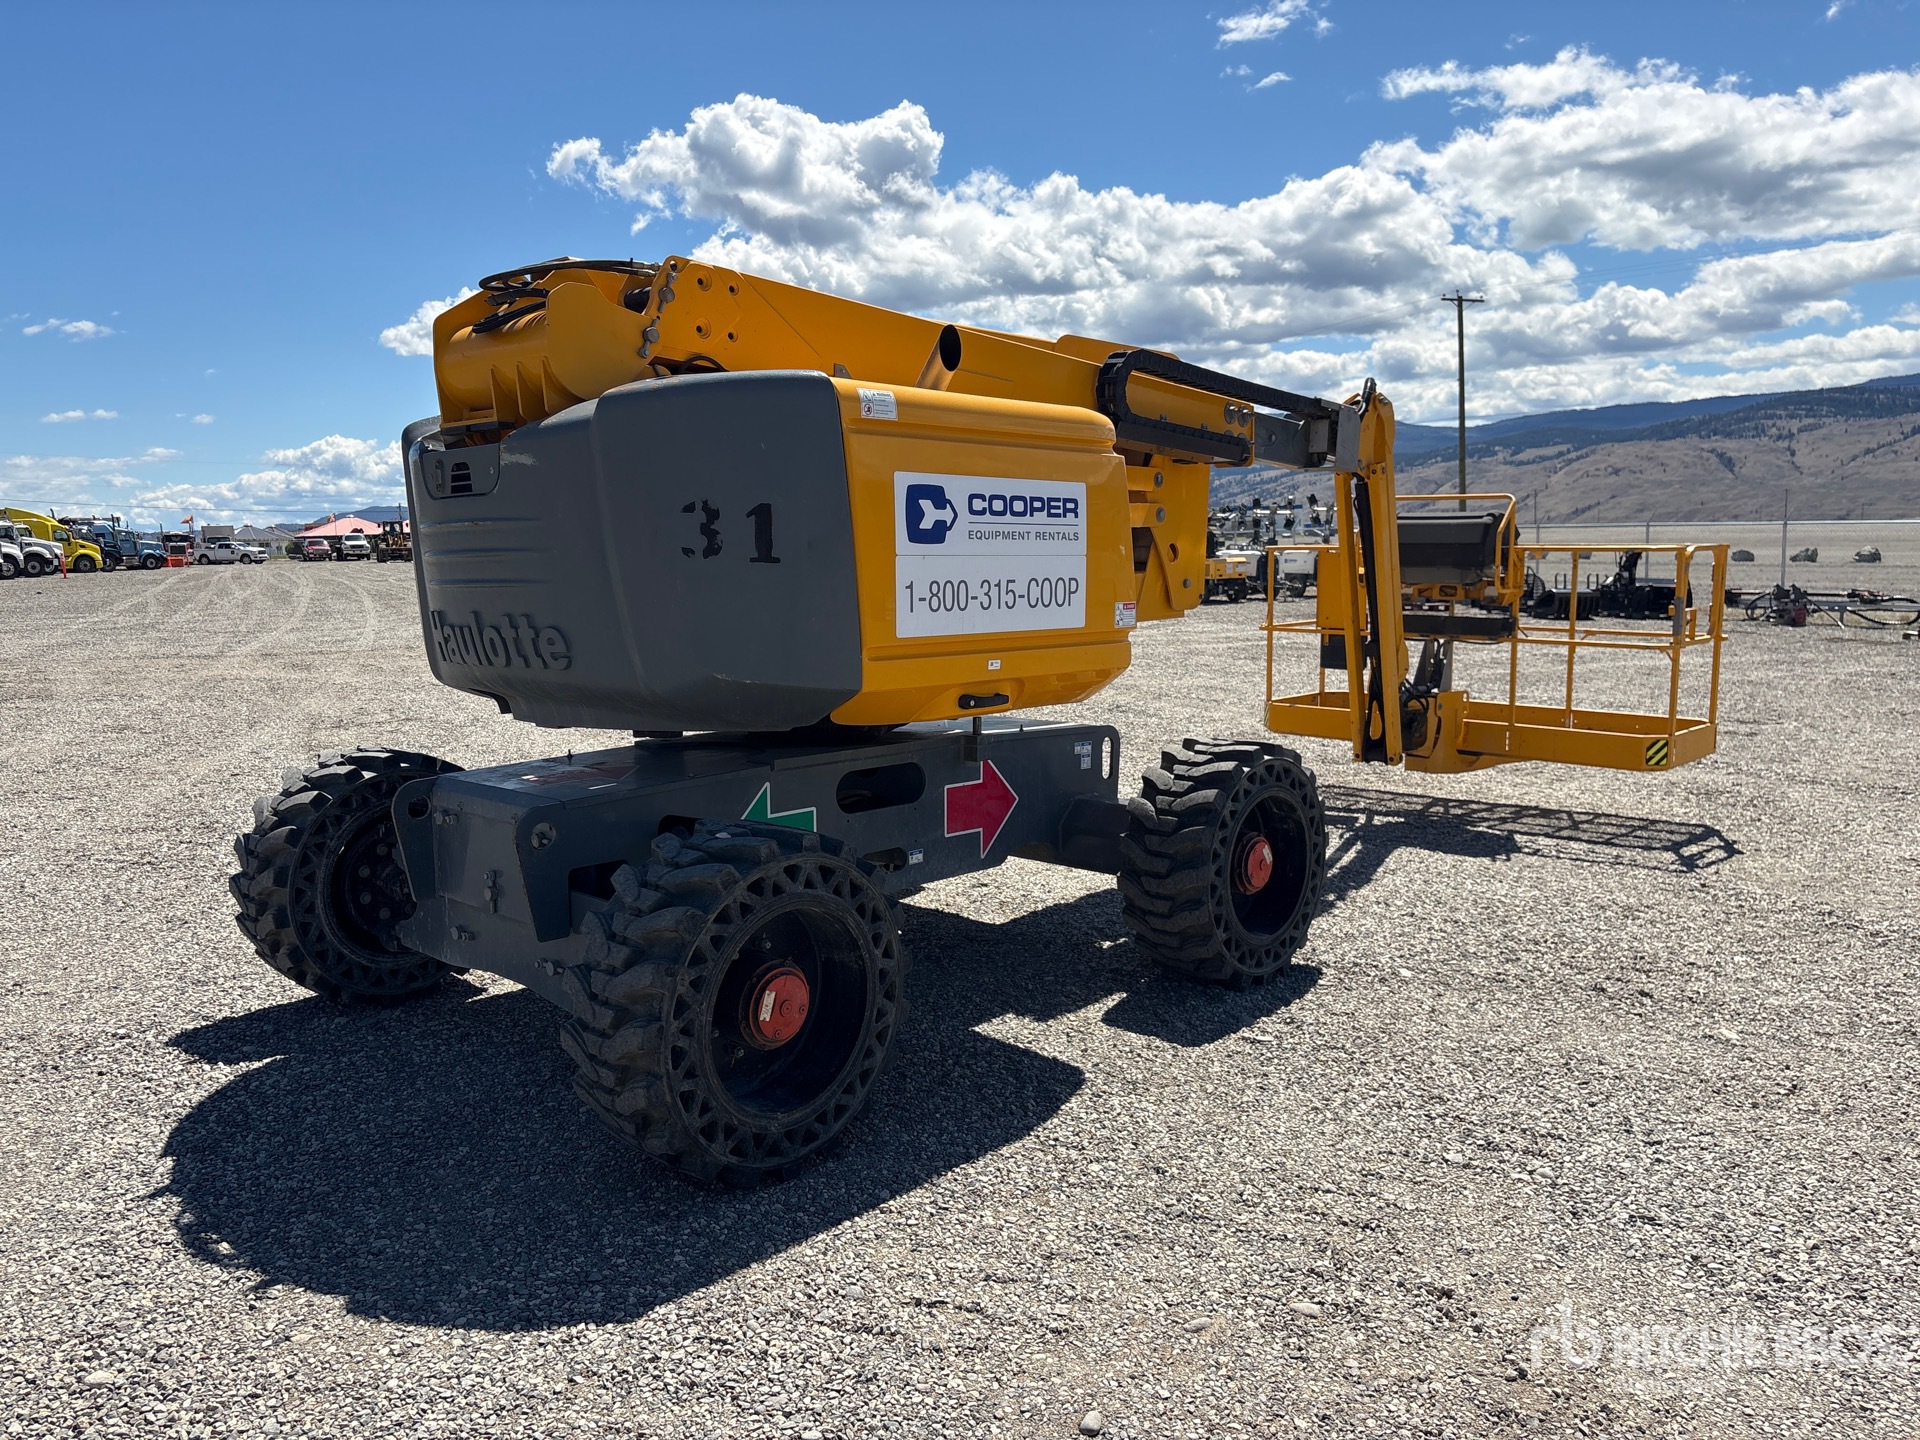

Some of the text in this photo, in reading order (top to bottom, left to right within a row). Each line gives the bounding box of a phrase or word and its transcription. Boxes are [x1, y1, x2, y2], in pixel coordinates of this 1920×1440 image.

[967, 493, 1079, 518] COOPER
[967, 530, 1080, 542] EQUIPMENT RENTALS
[905, 577, 1079, 613] 1-800-315-COOP
[429, 610, 573, 670] Haulotte
